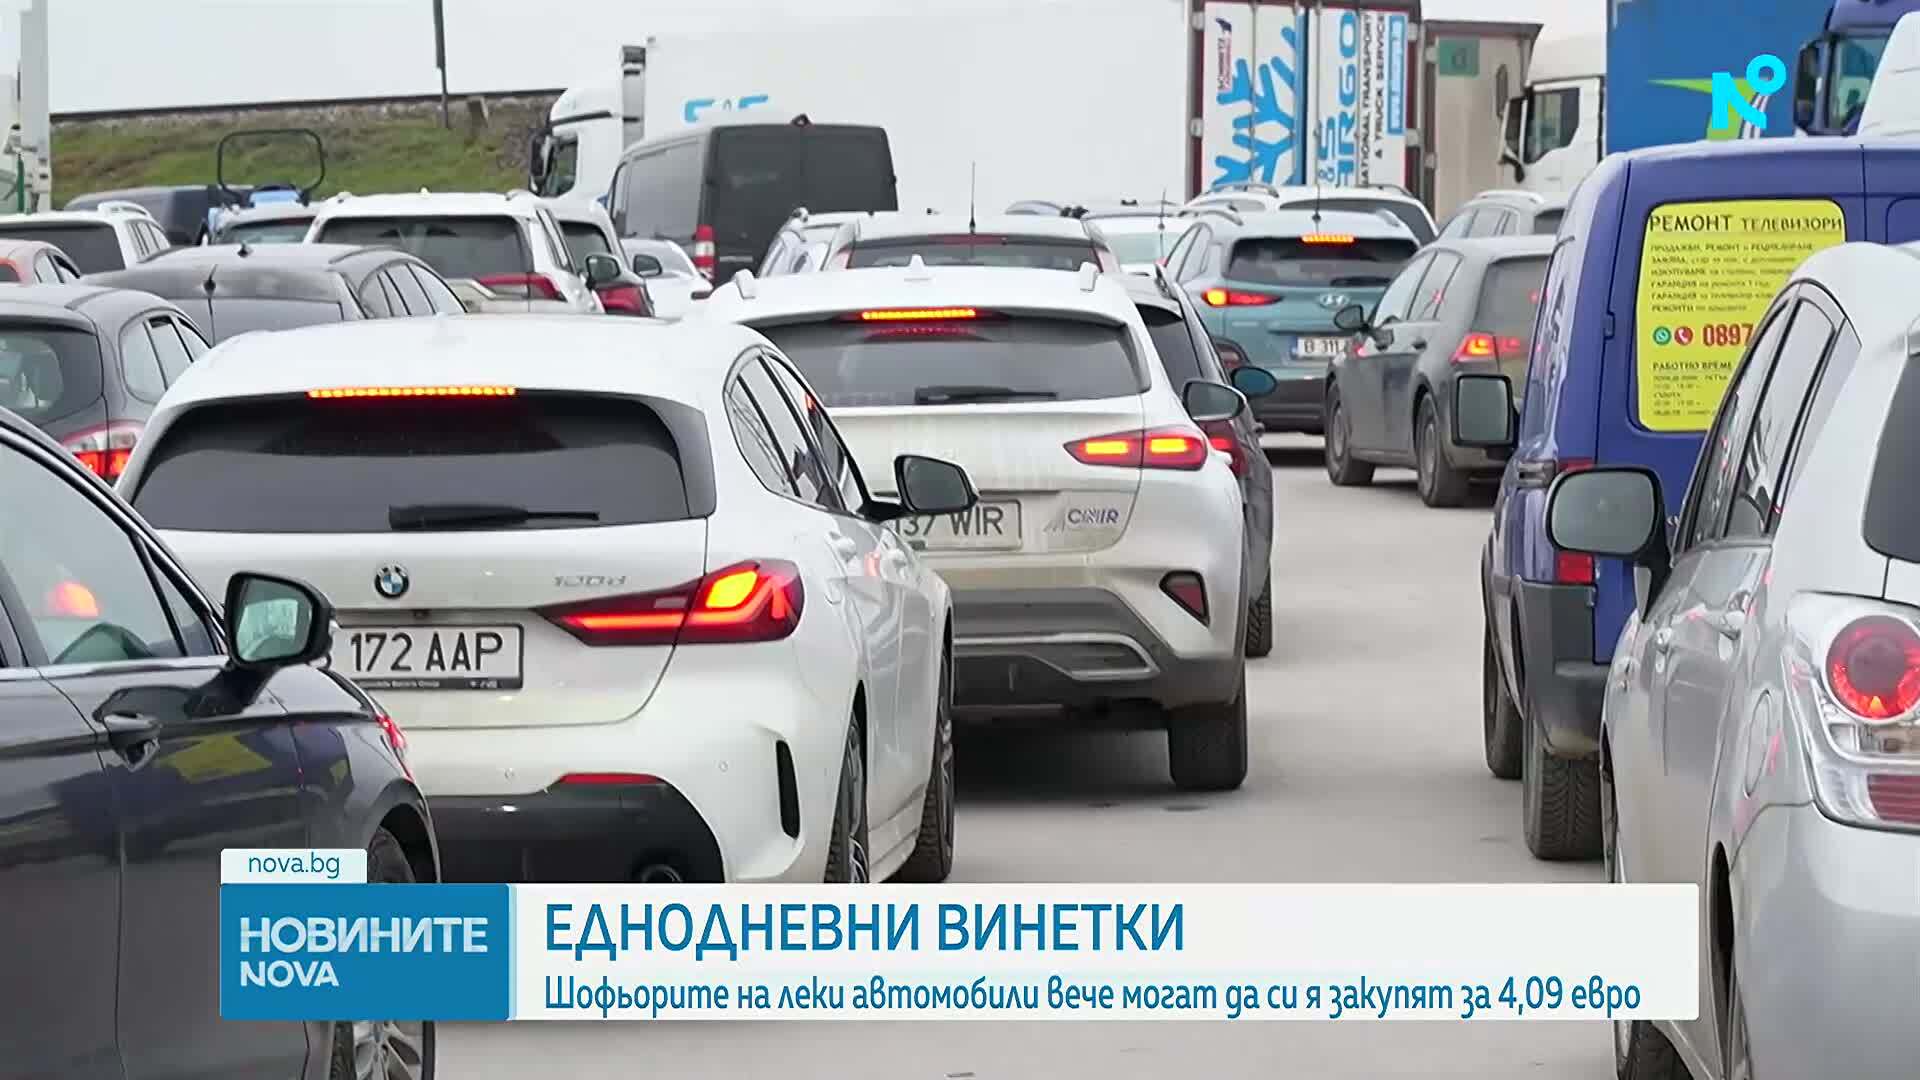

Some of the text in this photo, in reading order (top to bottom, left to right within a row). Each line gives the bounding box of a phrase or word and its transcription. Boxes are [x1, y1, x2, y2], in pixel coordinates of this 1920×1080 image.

[1338, 11, 1356, 187] ARGO
[1361, 111, 1370, 187] ATIONAL
[1650, 214, 1843, 233] РЕМОНТ ТЕЛЕВИЗОРИ
[1702, 323, 1754, 347] 0897
[950, 506, 1004, 536] WIR
[350, 631, 413, 673] 172
[424, 631, 504, 672] AAP
